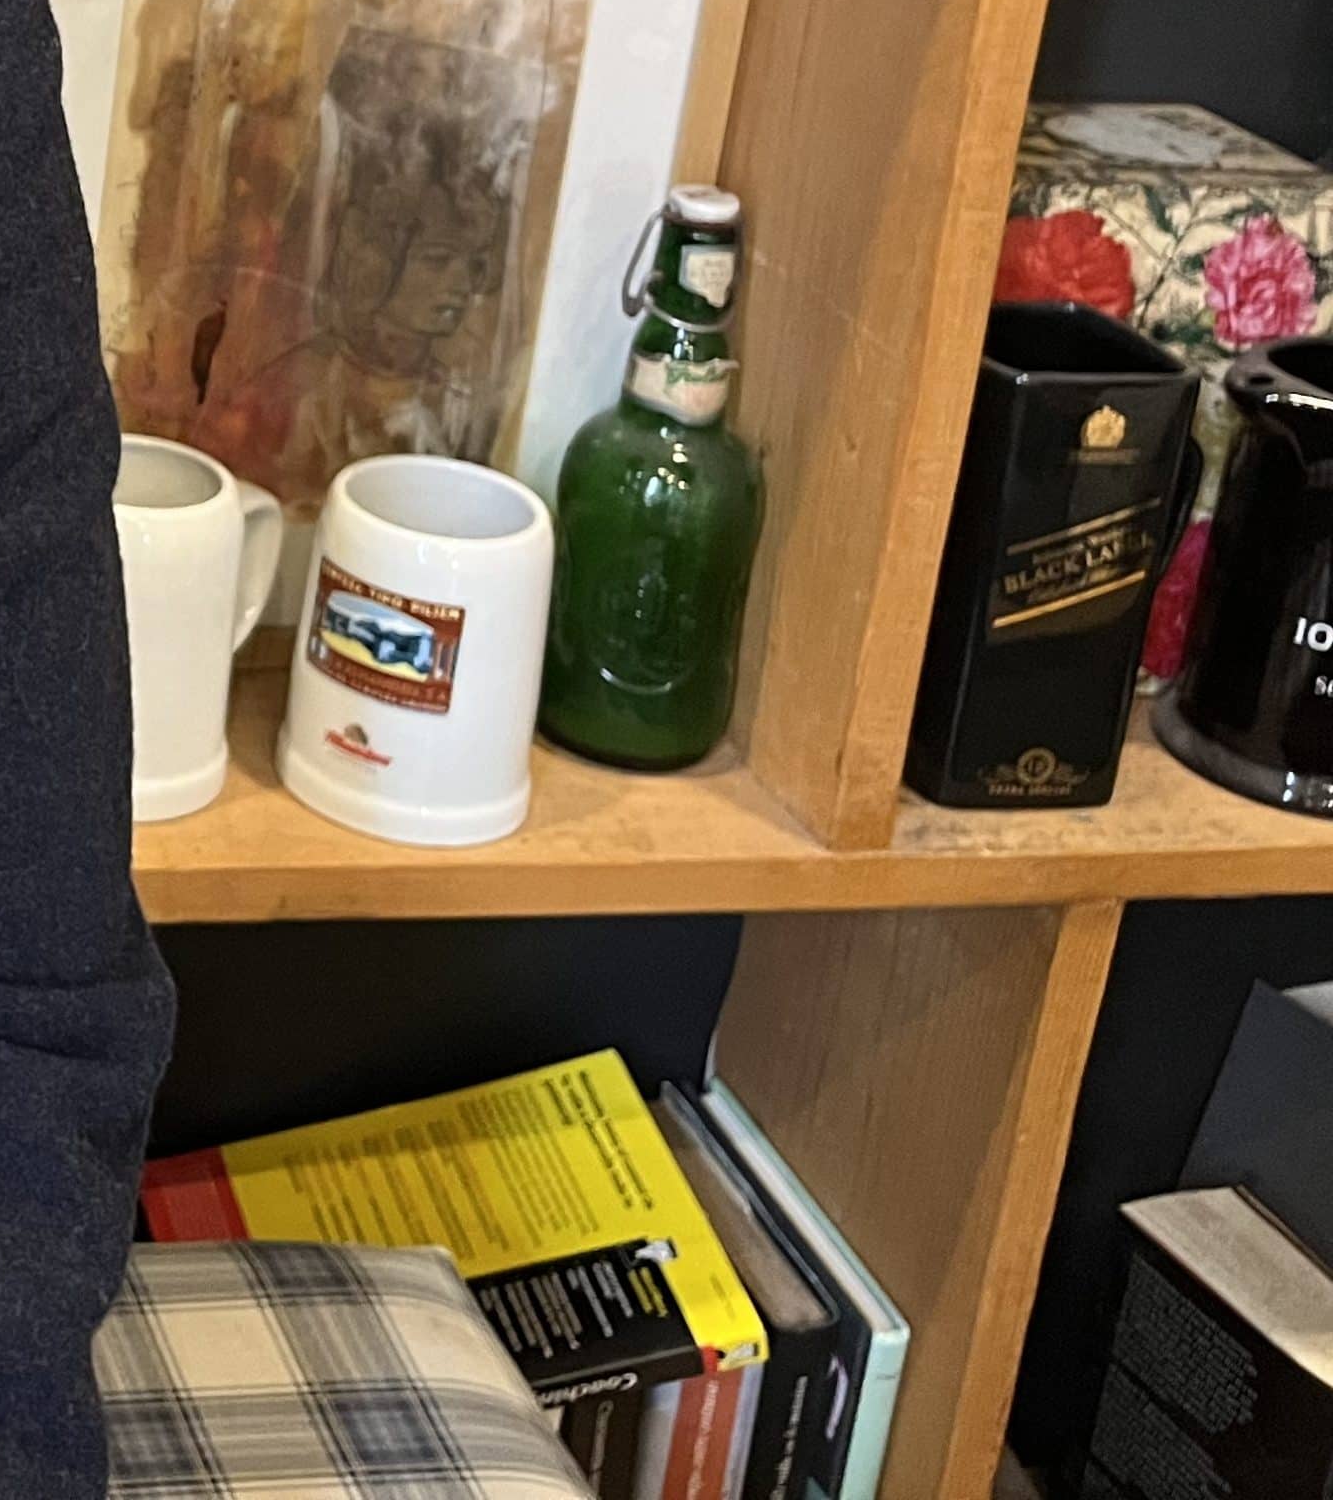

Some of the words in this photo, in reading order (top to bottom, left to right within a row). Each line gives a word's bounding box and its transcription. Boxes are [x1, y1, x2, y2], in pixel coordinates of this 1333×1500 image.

[1004, 554, 1082, 594] BLACK
[1085, 532, 1155, 568] LABL
[534, 1371, 639, 1404] Coachin
